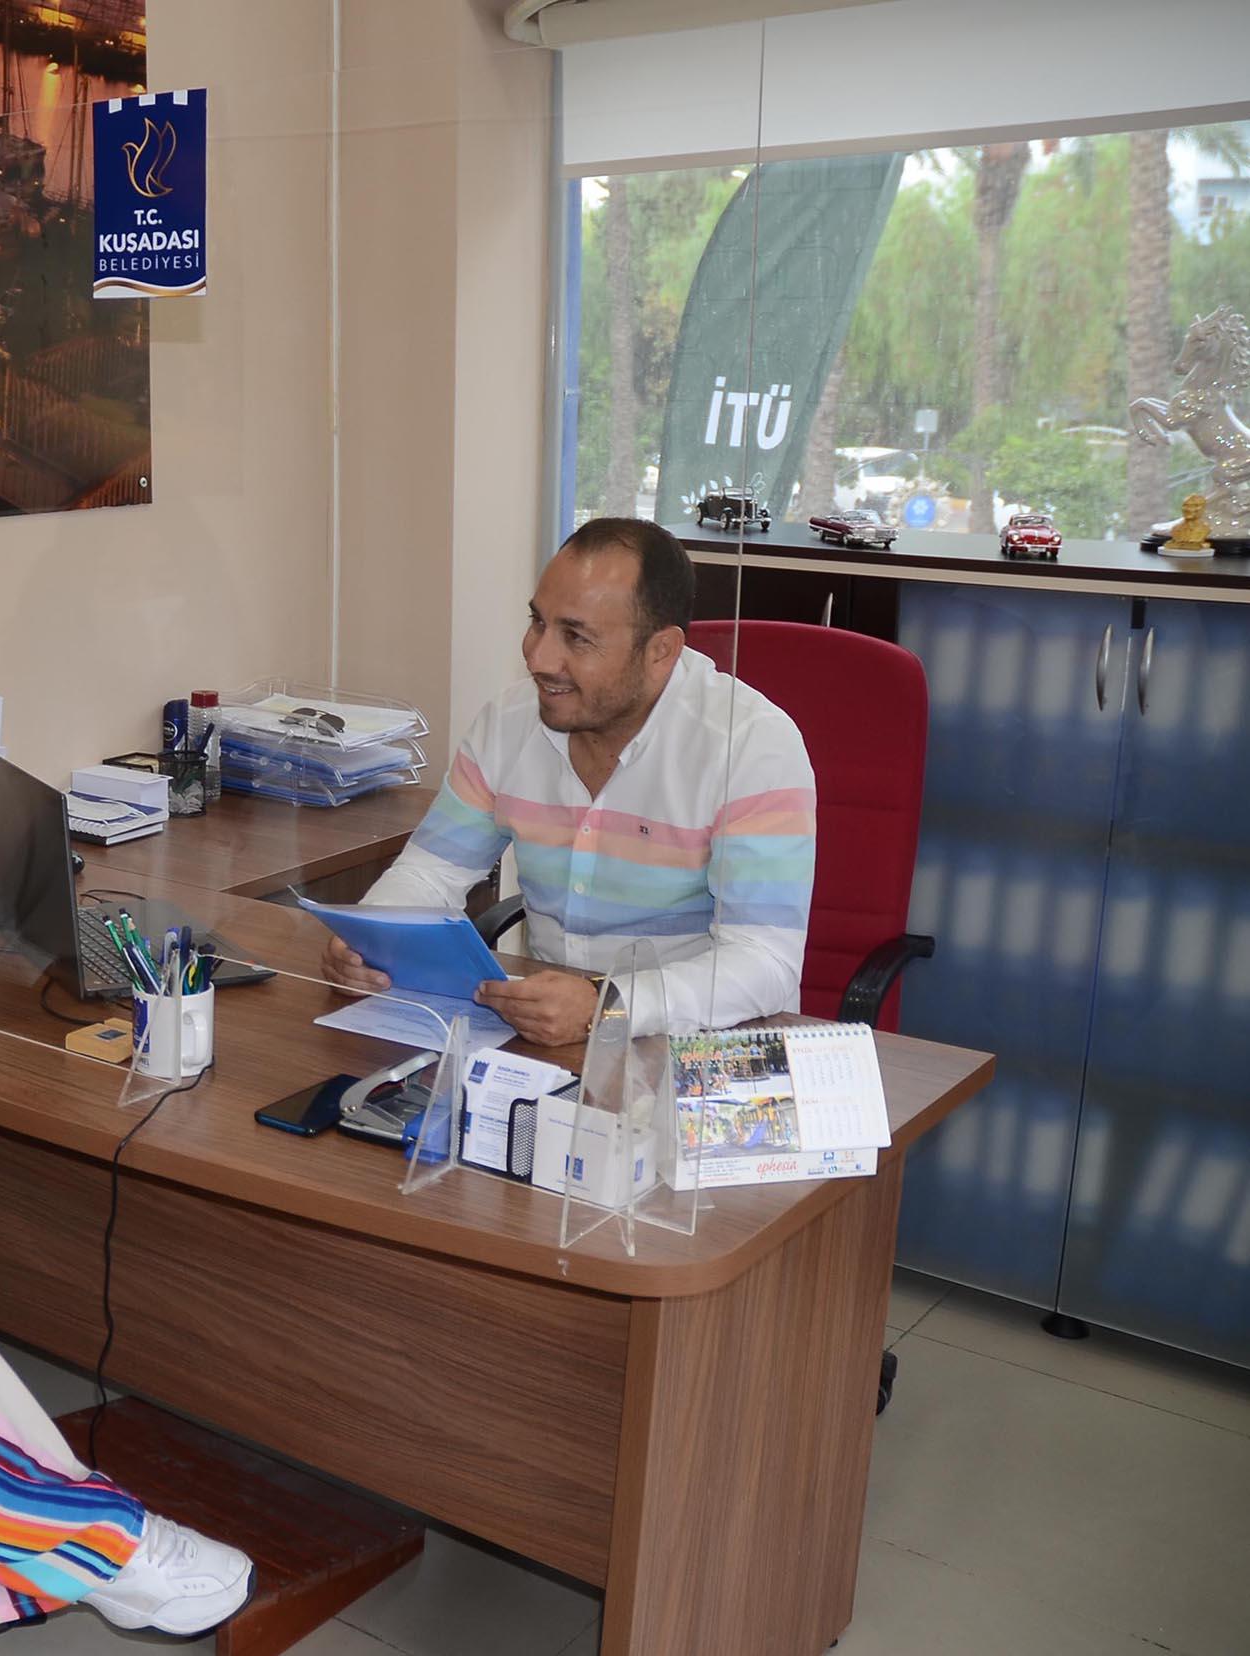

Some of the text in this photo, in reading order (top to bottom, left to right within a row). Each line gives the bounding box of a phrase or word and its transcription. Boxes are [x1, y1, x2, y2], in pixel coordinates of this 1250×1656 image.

[134, 209, 163, 225] T.C.
[99, 229, 199, 253] KUŞADASI
[99, 252, 199, 271] BELEDİYESİ
[705, 376, 791, 450] İTÜ
